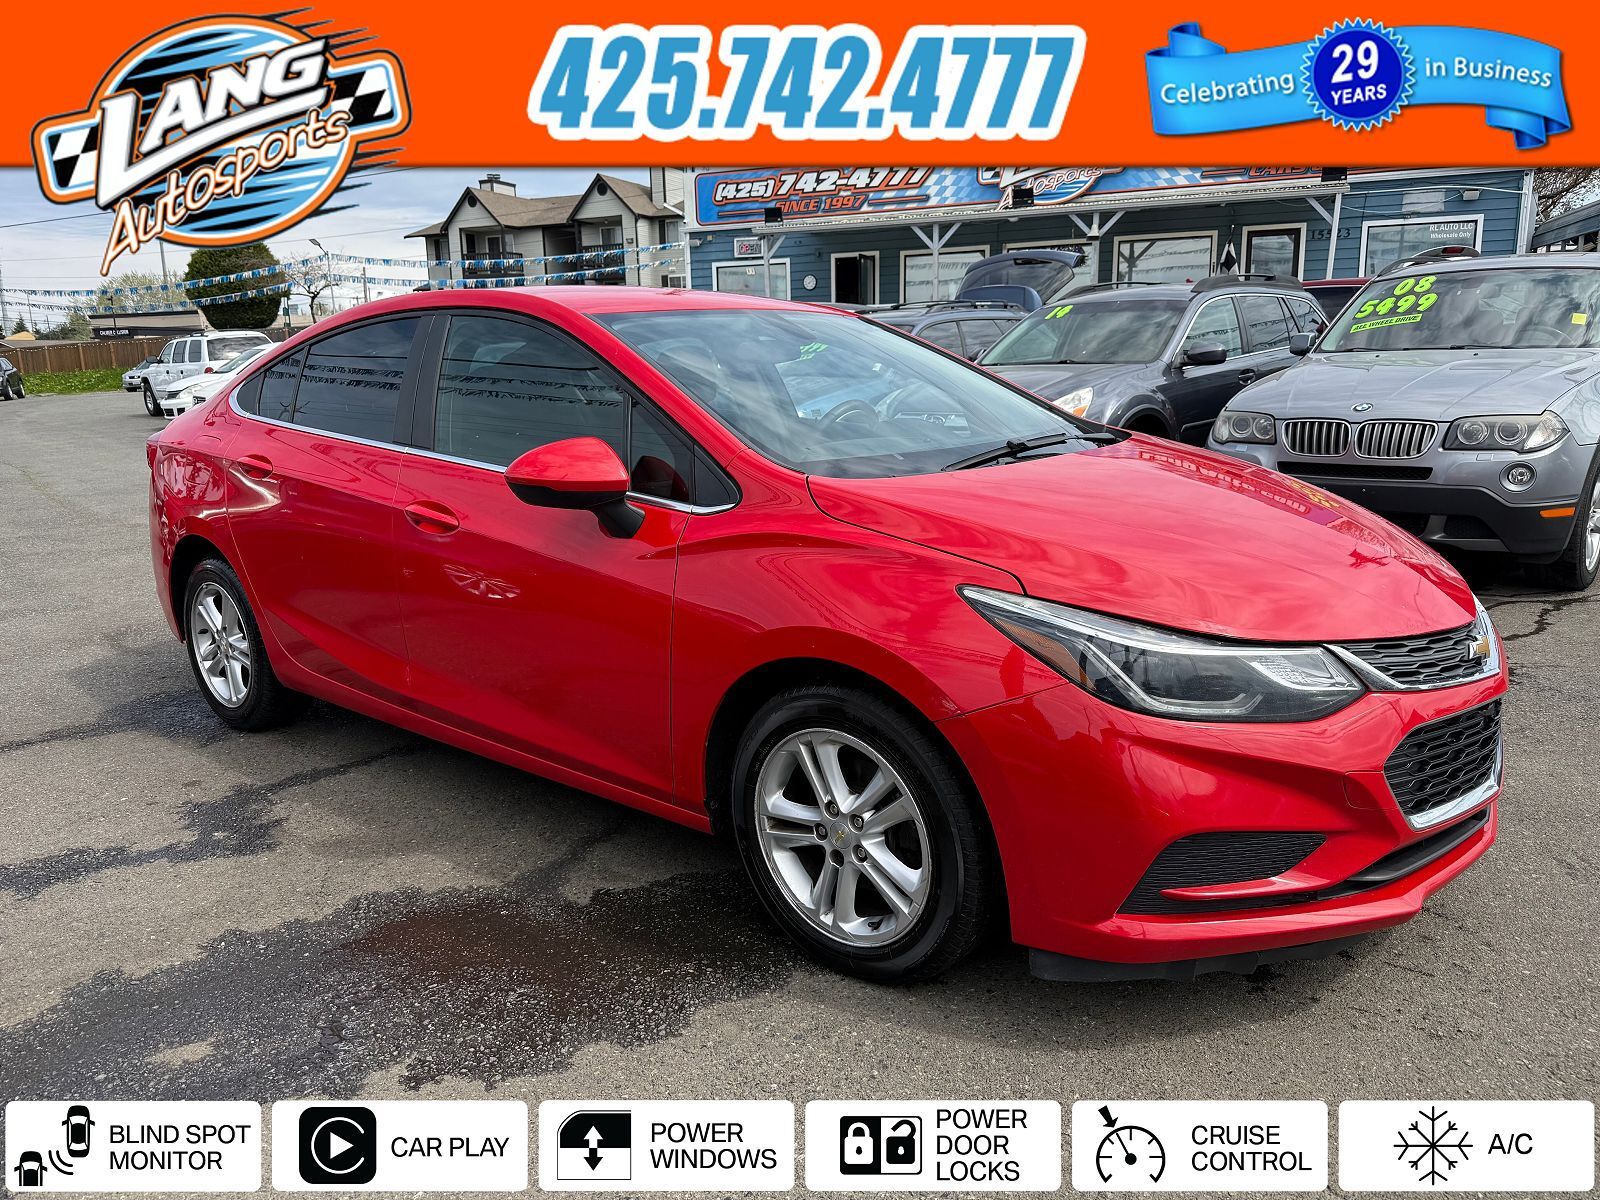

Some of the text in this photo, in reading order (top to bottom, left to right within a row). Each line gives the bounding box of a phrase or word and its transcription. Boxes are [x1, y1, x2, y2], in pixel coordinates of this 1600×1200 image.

[716, 166, 922, 200] (425) 742-4777
[775, 195, 868, 213] SINCE 1997
[1429, 222, 1474, 232] RL AUTO LLC
[1459, 231, 1472, 239] Only
[1393, 275, 1437, 296] 08
[1354, 293, 1438, 319] 5499
[1353, 314, 1420, 332] ALL WHEEL DRIVE
